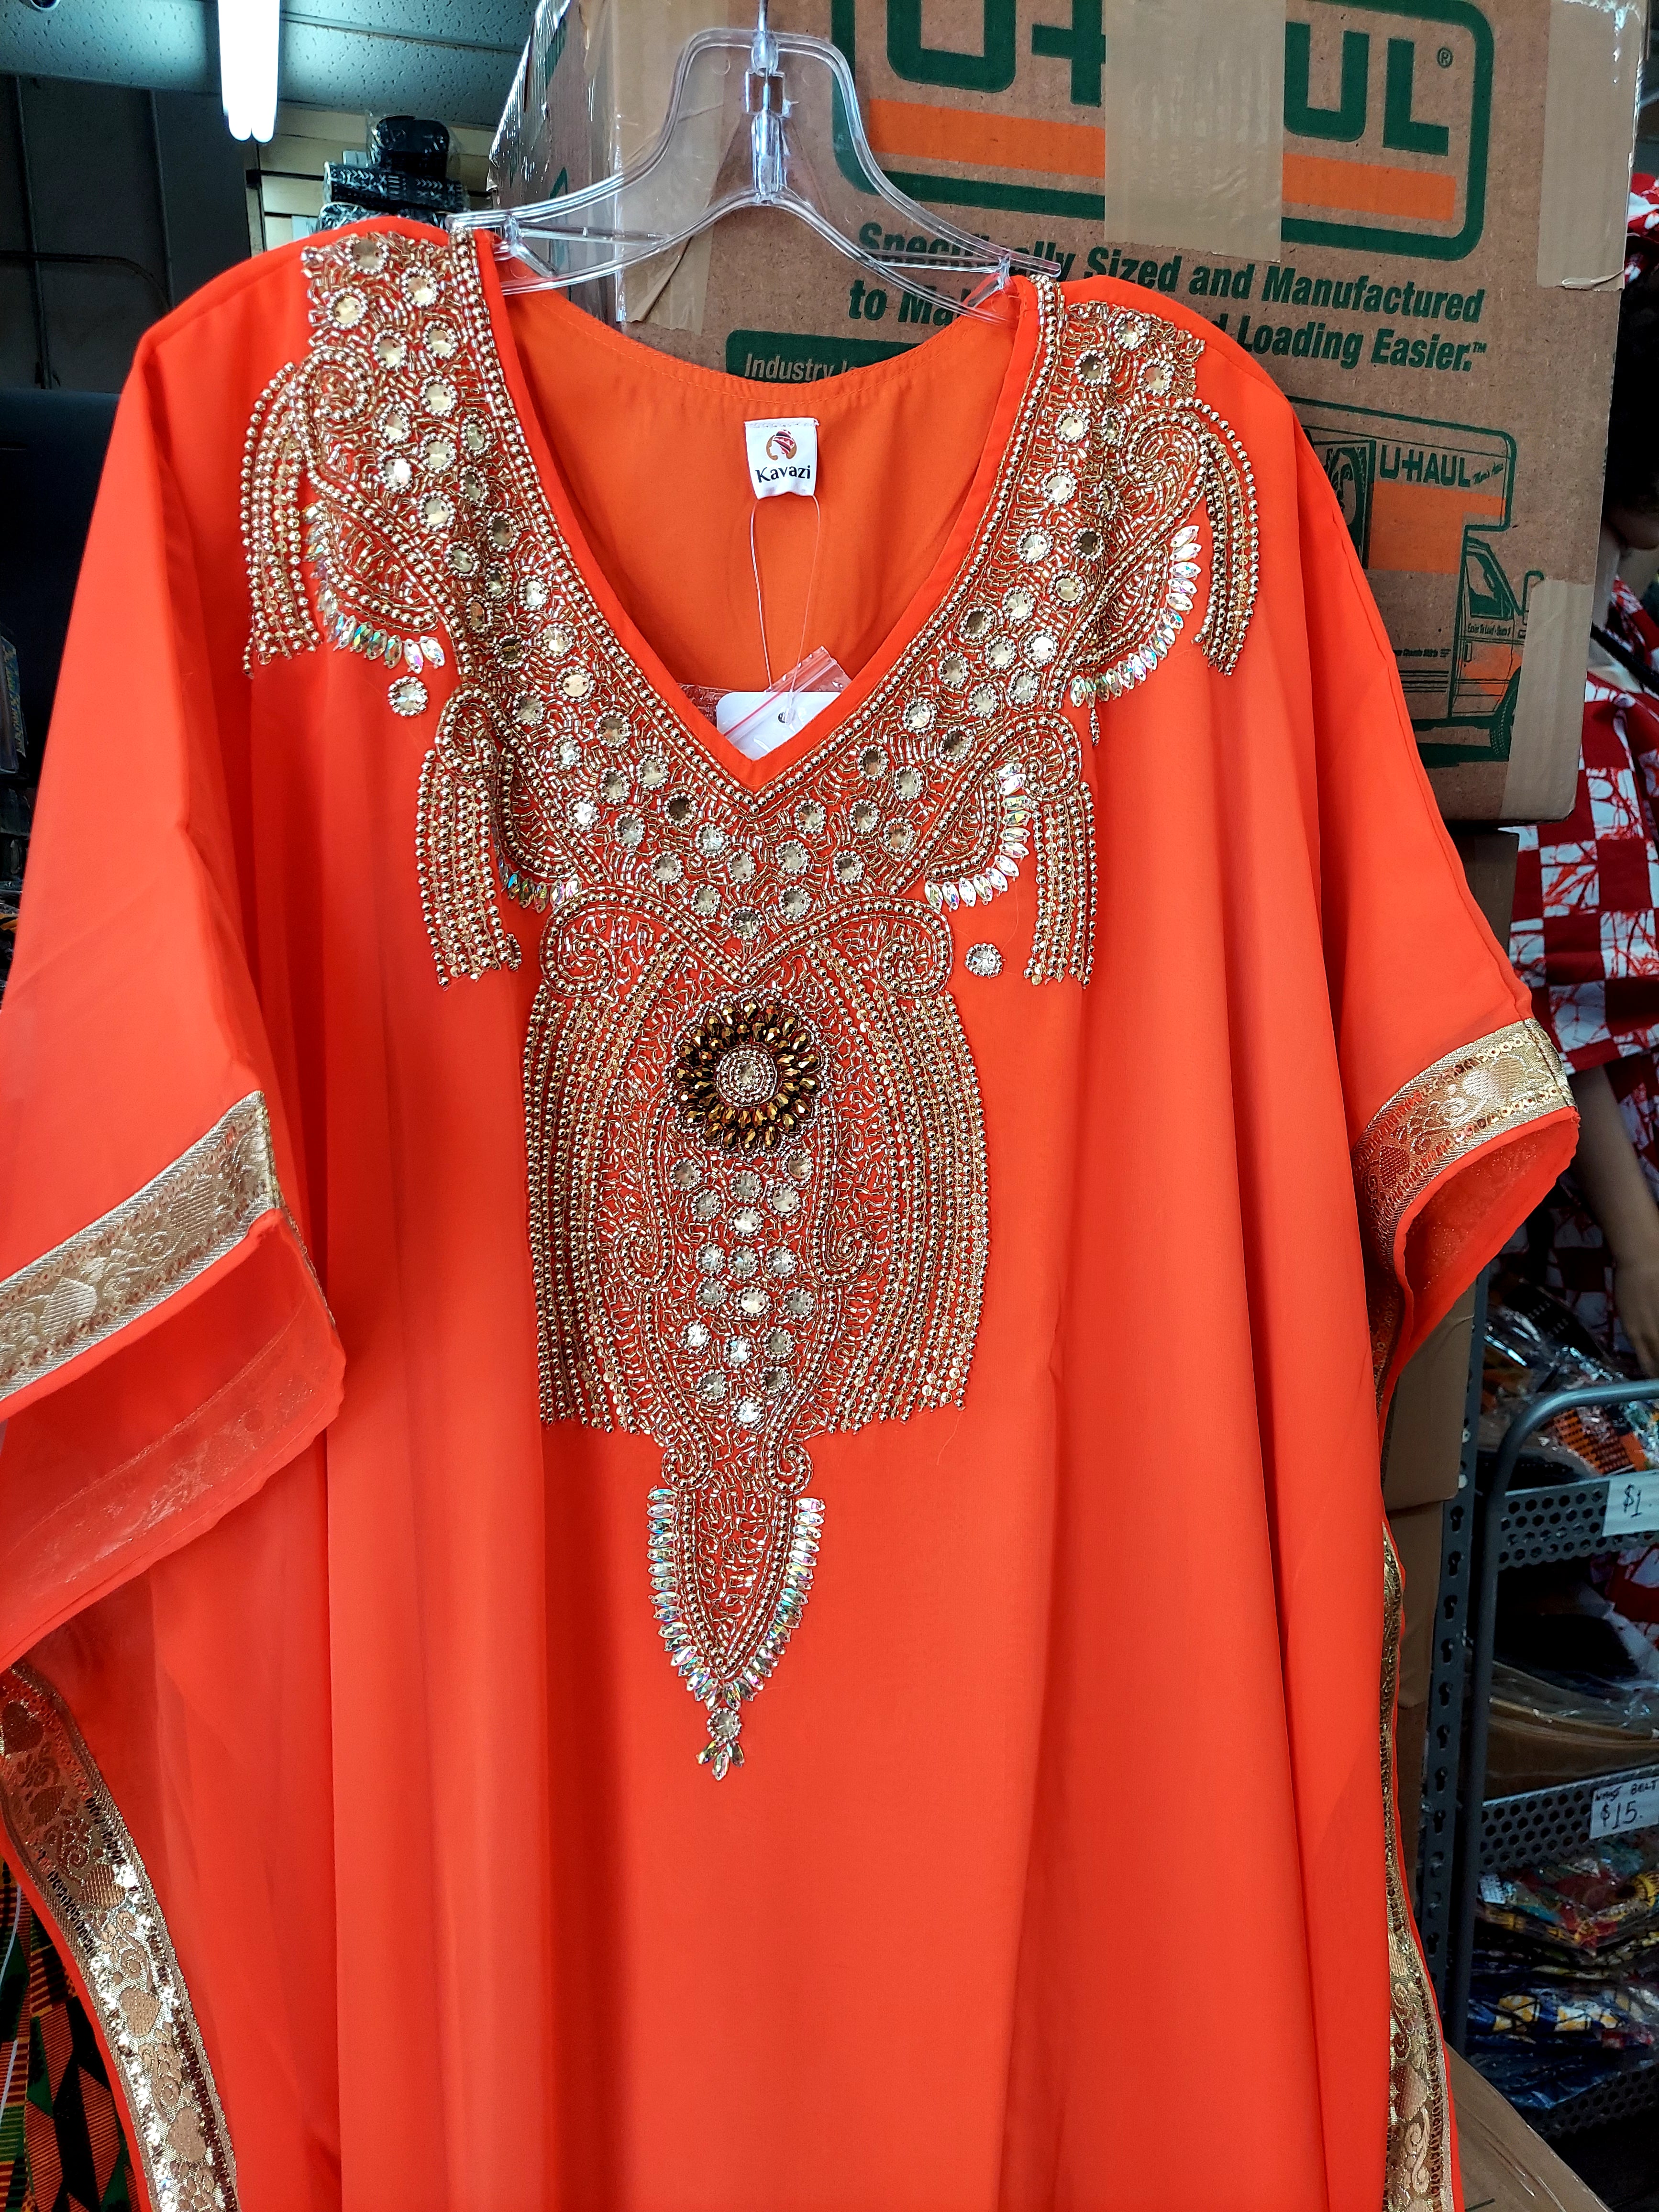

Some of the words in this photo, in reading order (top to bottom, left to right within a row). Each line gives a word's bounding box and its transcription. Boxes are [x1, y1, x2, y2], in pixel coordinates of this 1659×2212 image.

[1084, 246, 1182, 293] Sized
[1188, 263, 1254, 299] and
[1261, 265, 1485, 323] Manufactured
[848, 279, 887, 321] to
[1237, 315, 1365, 370] Loading
[745, 353, 834, 382] Industry
[755, 465, 811, 483] Kavazi
[1380, 444, 1471, 487] U-HAUL
